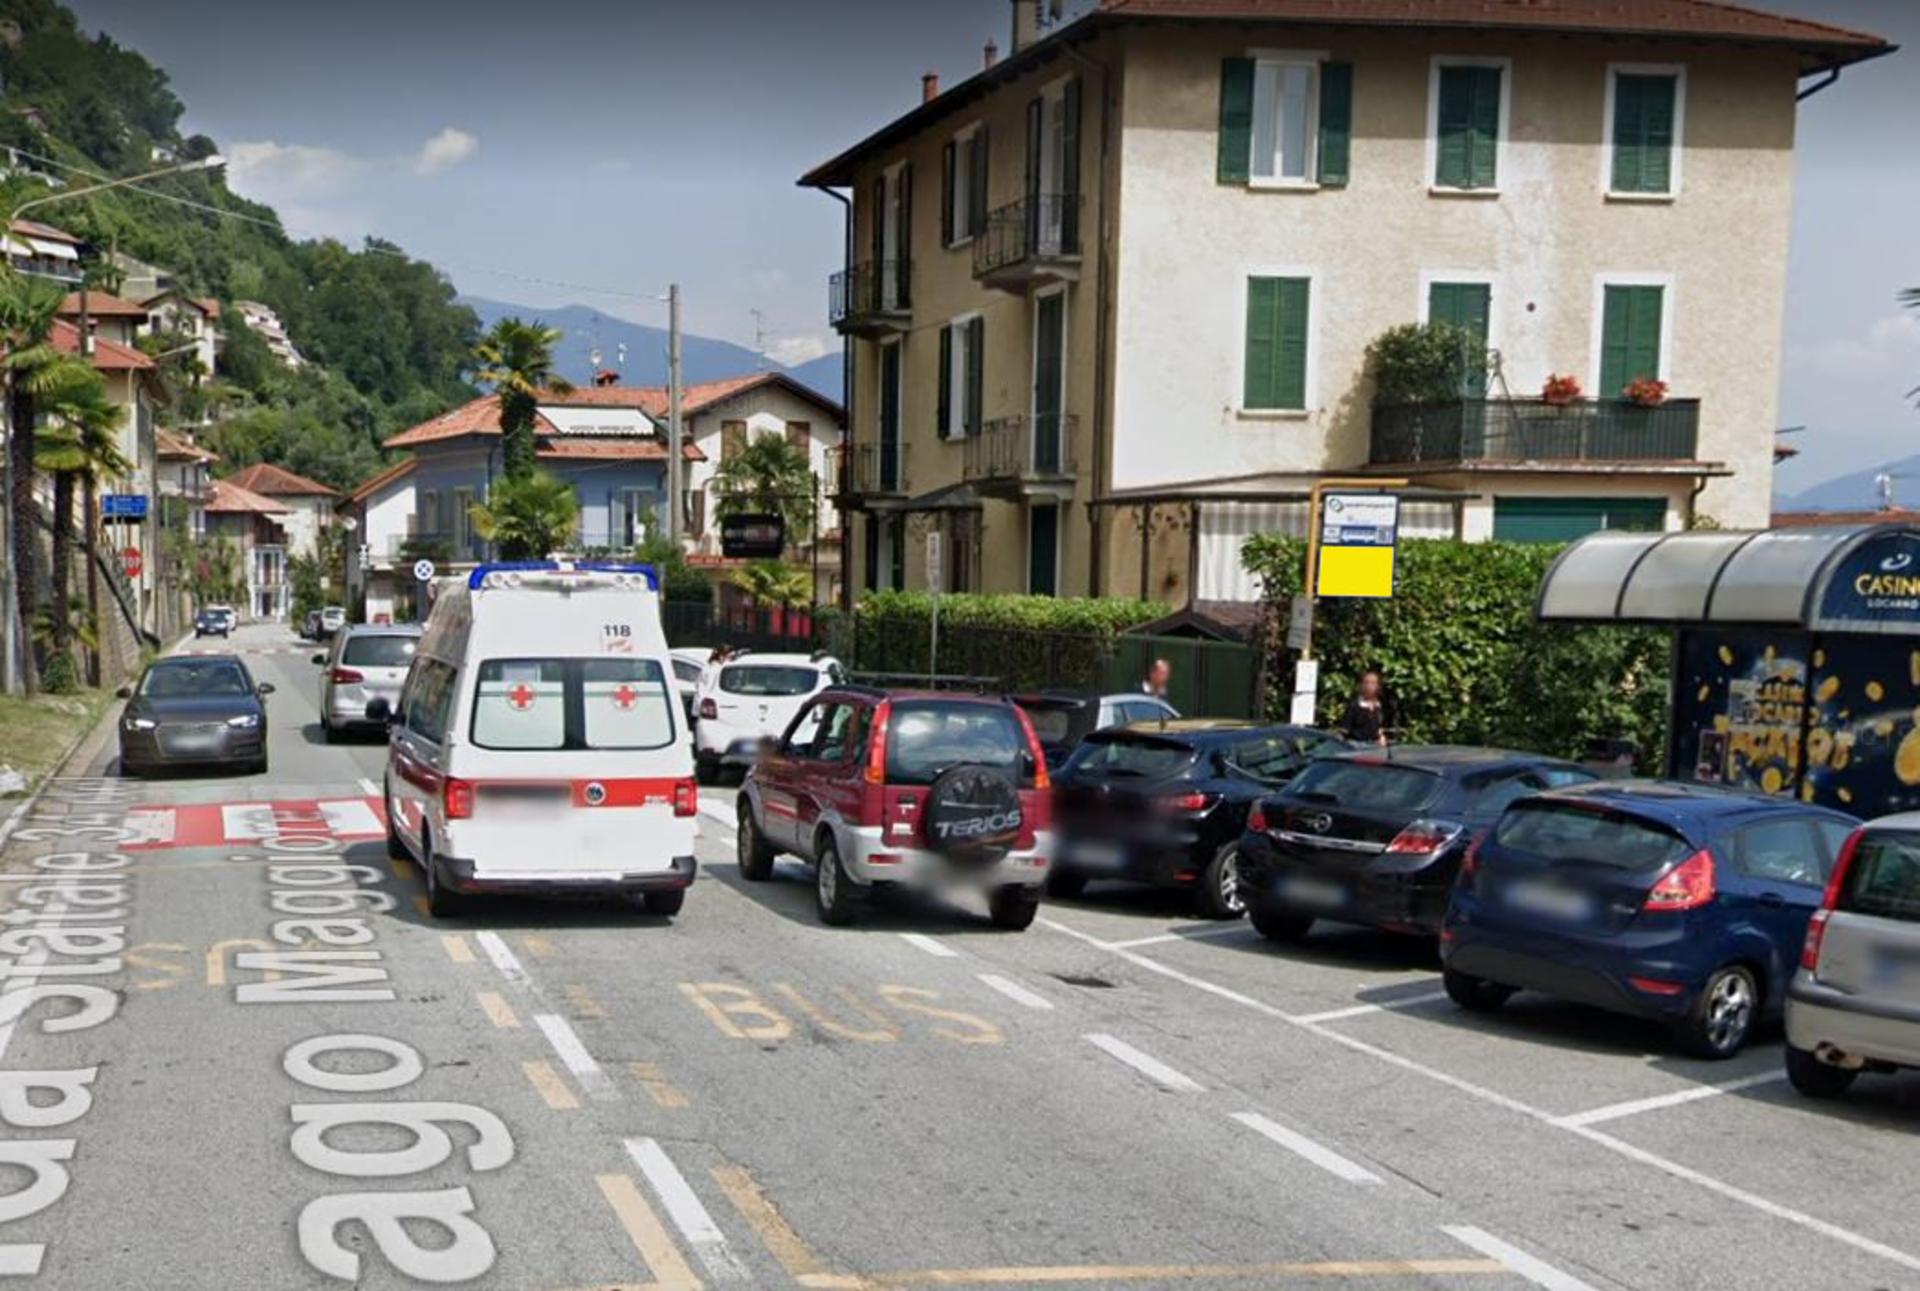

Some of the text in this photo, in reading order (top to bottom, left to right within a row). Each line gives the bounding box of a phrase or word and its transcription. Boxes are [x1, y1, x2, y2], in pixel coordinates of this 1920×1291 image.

[604, 625, 631, 637] 118
[935, 810, 1021, 838] TERIOS
[677, 982, 1006, 1044] BUS
